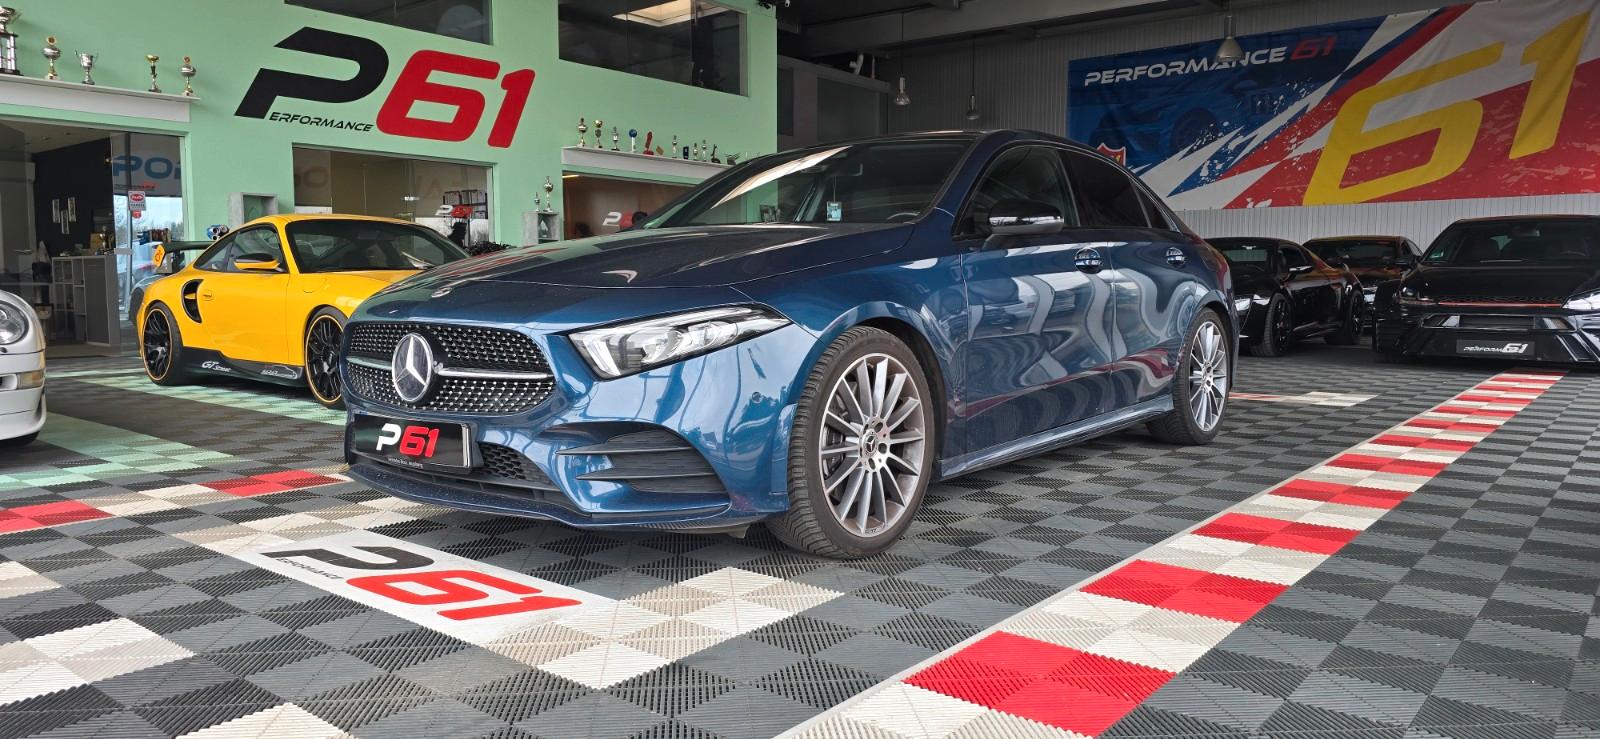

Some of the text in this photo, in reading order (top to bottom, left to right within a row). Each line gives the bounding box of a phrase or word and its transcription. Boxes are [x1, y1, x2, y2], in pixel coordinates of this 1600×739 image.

[1291, 35, 1338, 60] 61
[235, 26, 535, 148] P61
[268, 112, 374, 132] ERFORMANCE
[1302, 9, 1591, 206] 61
[375, 422, 440, 458] P61
